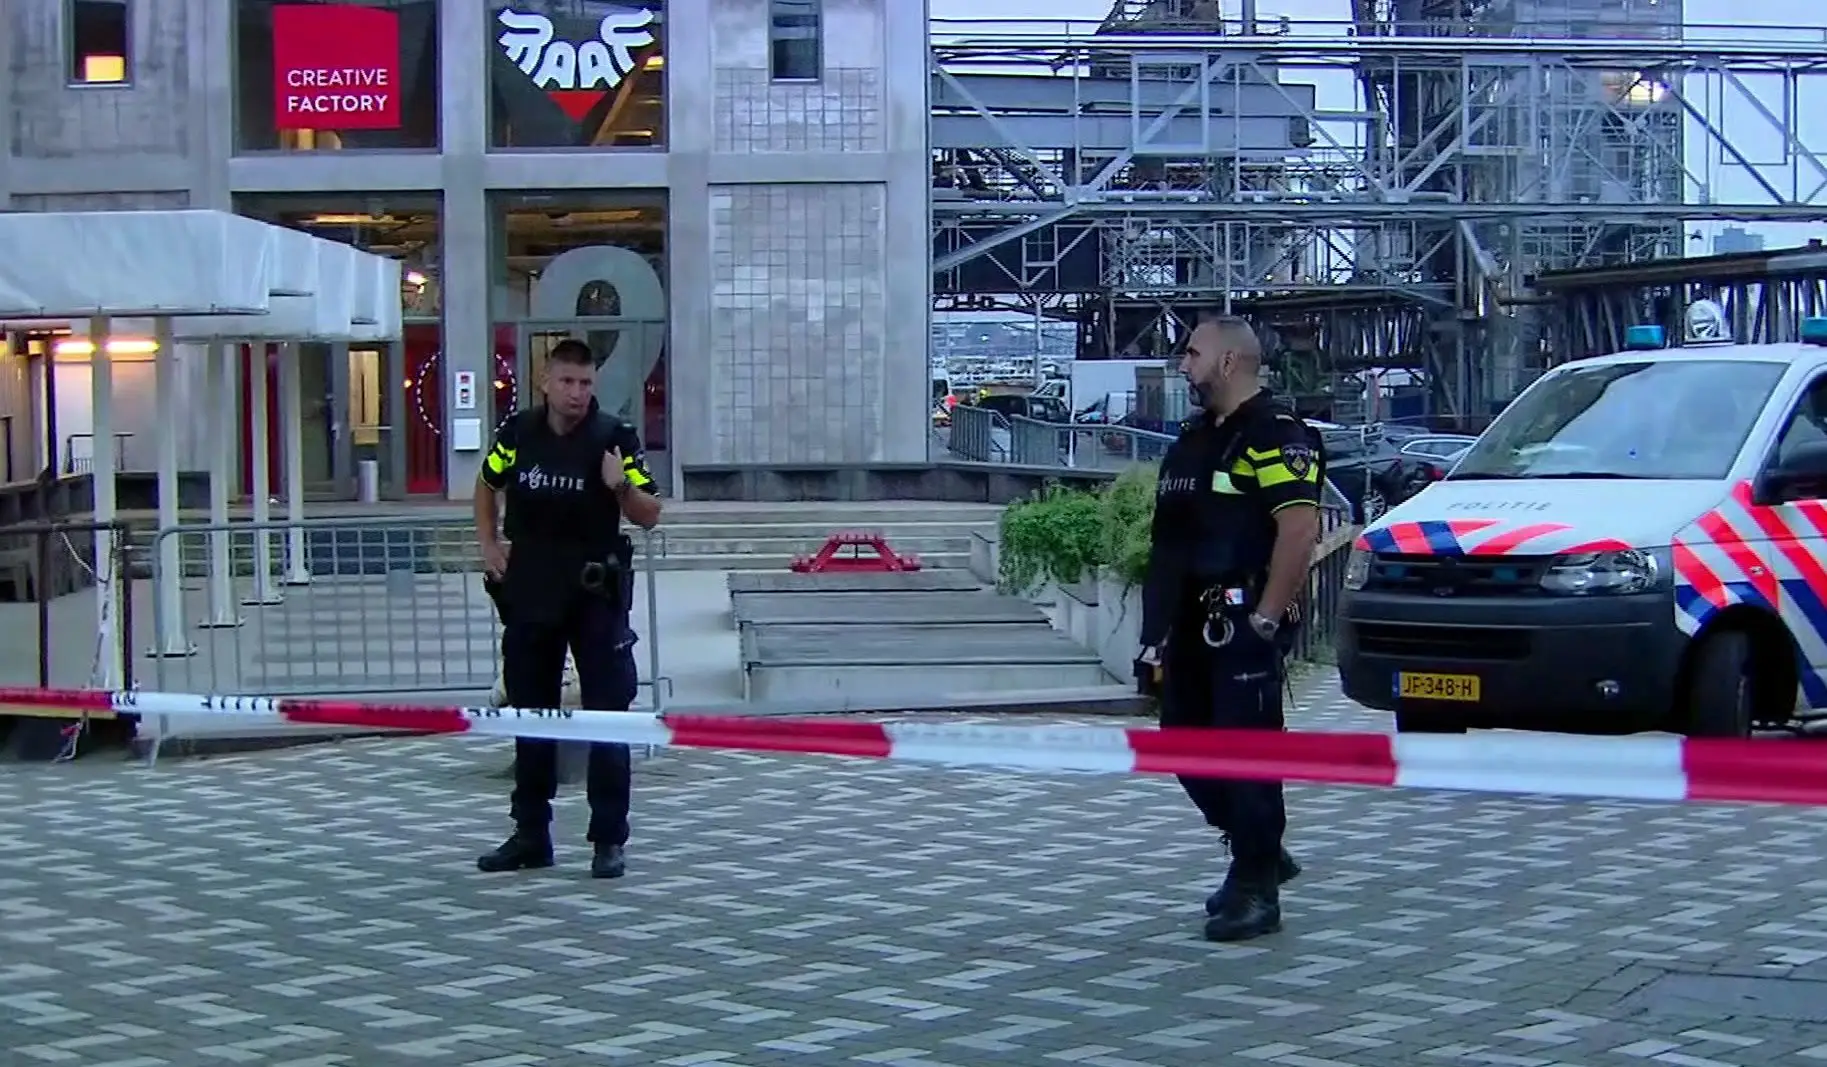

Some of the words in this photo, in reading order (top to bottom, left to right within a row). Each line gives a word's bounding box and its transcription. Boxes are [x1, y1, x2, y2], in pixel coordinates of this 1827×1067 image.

[287, 68, 389, 87] CREATIVE
[287, 94, 388, 113] FACTORY
[518, 466, 585, 491] POLITIE
[1446, 501, 1552, 512] POLITIE
[1404, 676, 1472, 696] JF-348-H
